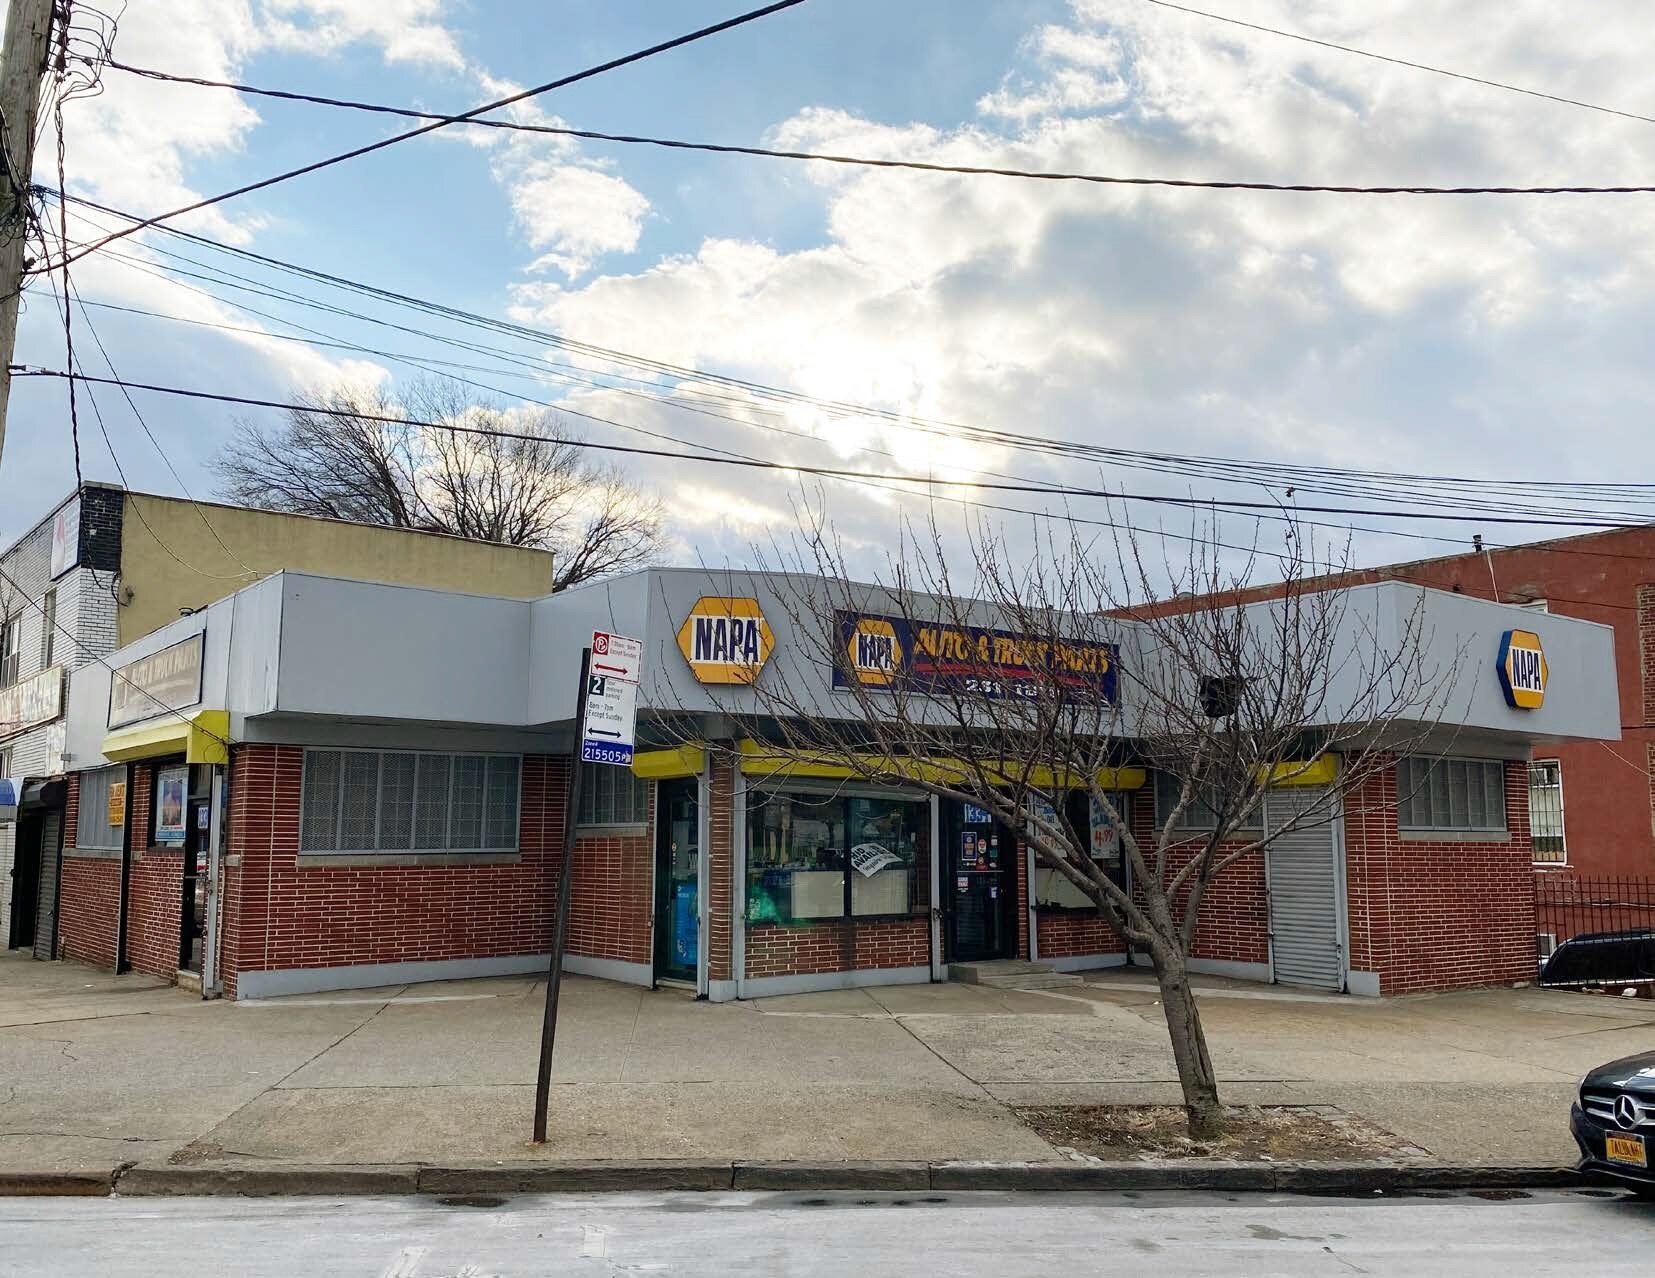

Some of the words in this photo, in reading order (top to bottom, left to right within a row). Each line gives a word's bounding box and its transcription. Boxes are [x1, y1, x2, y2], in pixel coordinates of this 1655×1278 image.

[694, 617, 759, 664] NAPA
[858, 634, 893, 668] NAPA
[1511, 647, 1543, 691] NAPA
[592, 676, 602, 694] 2
[588, 708, 605, 720] Except
[584, 747, 621, 762] 215505
